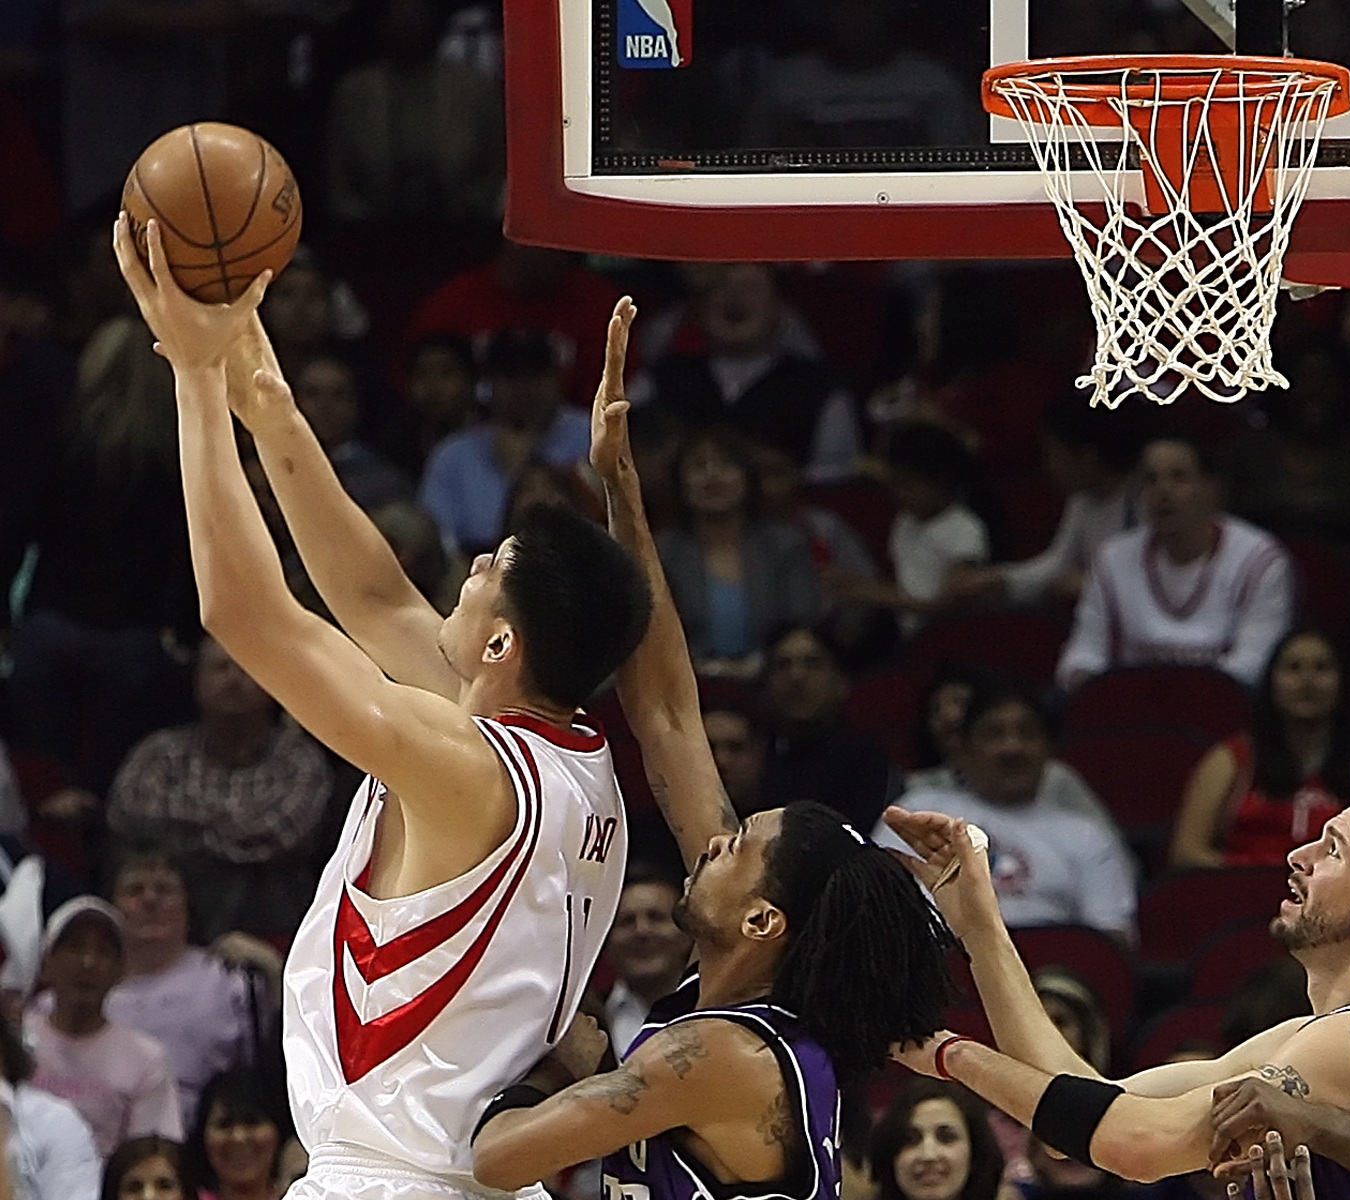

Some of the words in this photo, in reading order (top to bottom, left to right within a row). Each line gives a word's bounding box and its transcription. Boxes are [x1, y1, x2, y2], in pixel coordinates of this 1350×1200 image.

[625, 34, 668, 58] NBA
[579, 813, 618, 864] YAO
[545, 893, 593, 1045] 1
